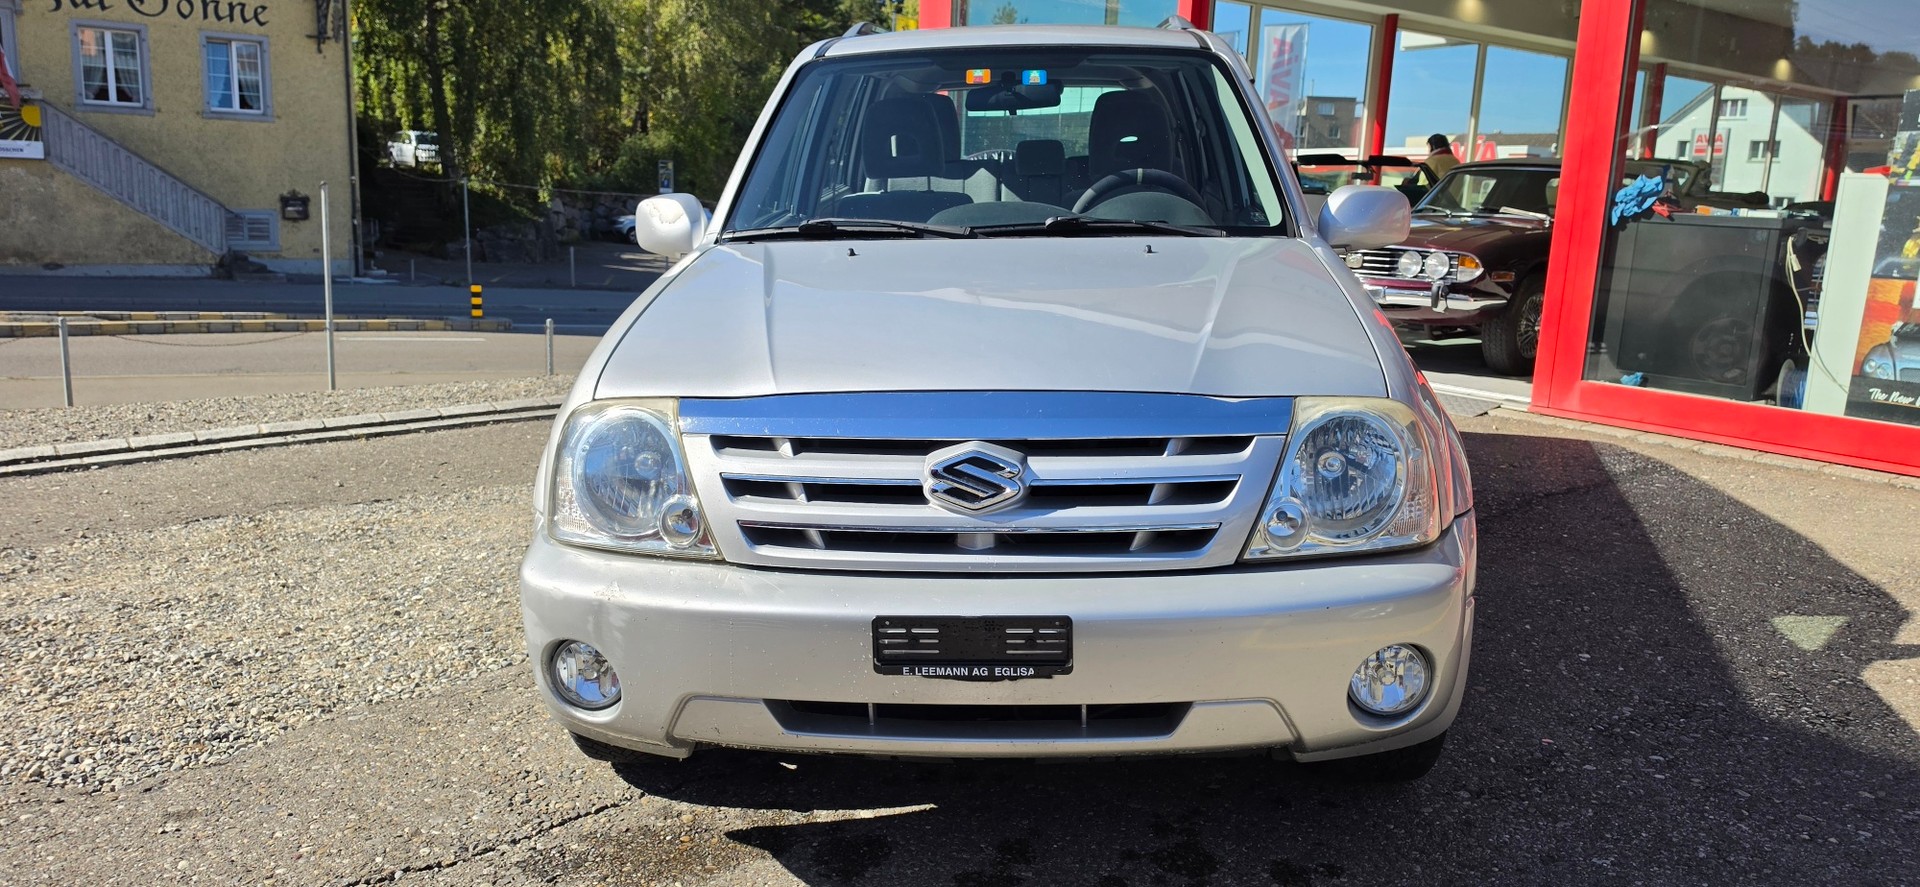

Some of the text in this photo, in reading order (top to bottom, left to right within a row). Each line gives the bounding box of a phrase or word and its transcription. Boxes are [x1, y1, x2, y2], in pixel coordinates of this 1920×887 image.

[1869, 387, 1888, 400] The
[1889, 391, 1915, 404] New
[902, 667, 1035, 676] E. LEEMANN AG EGLISA
